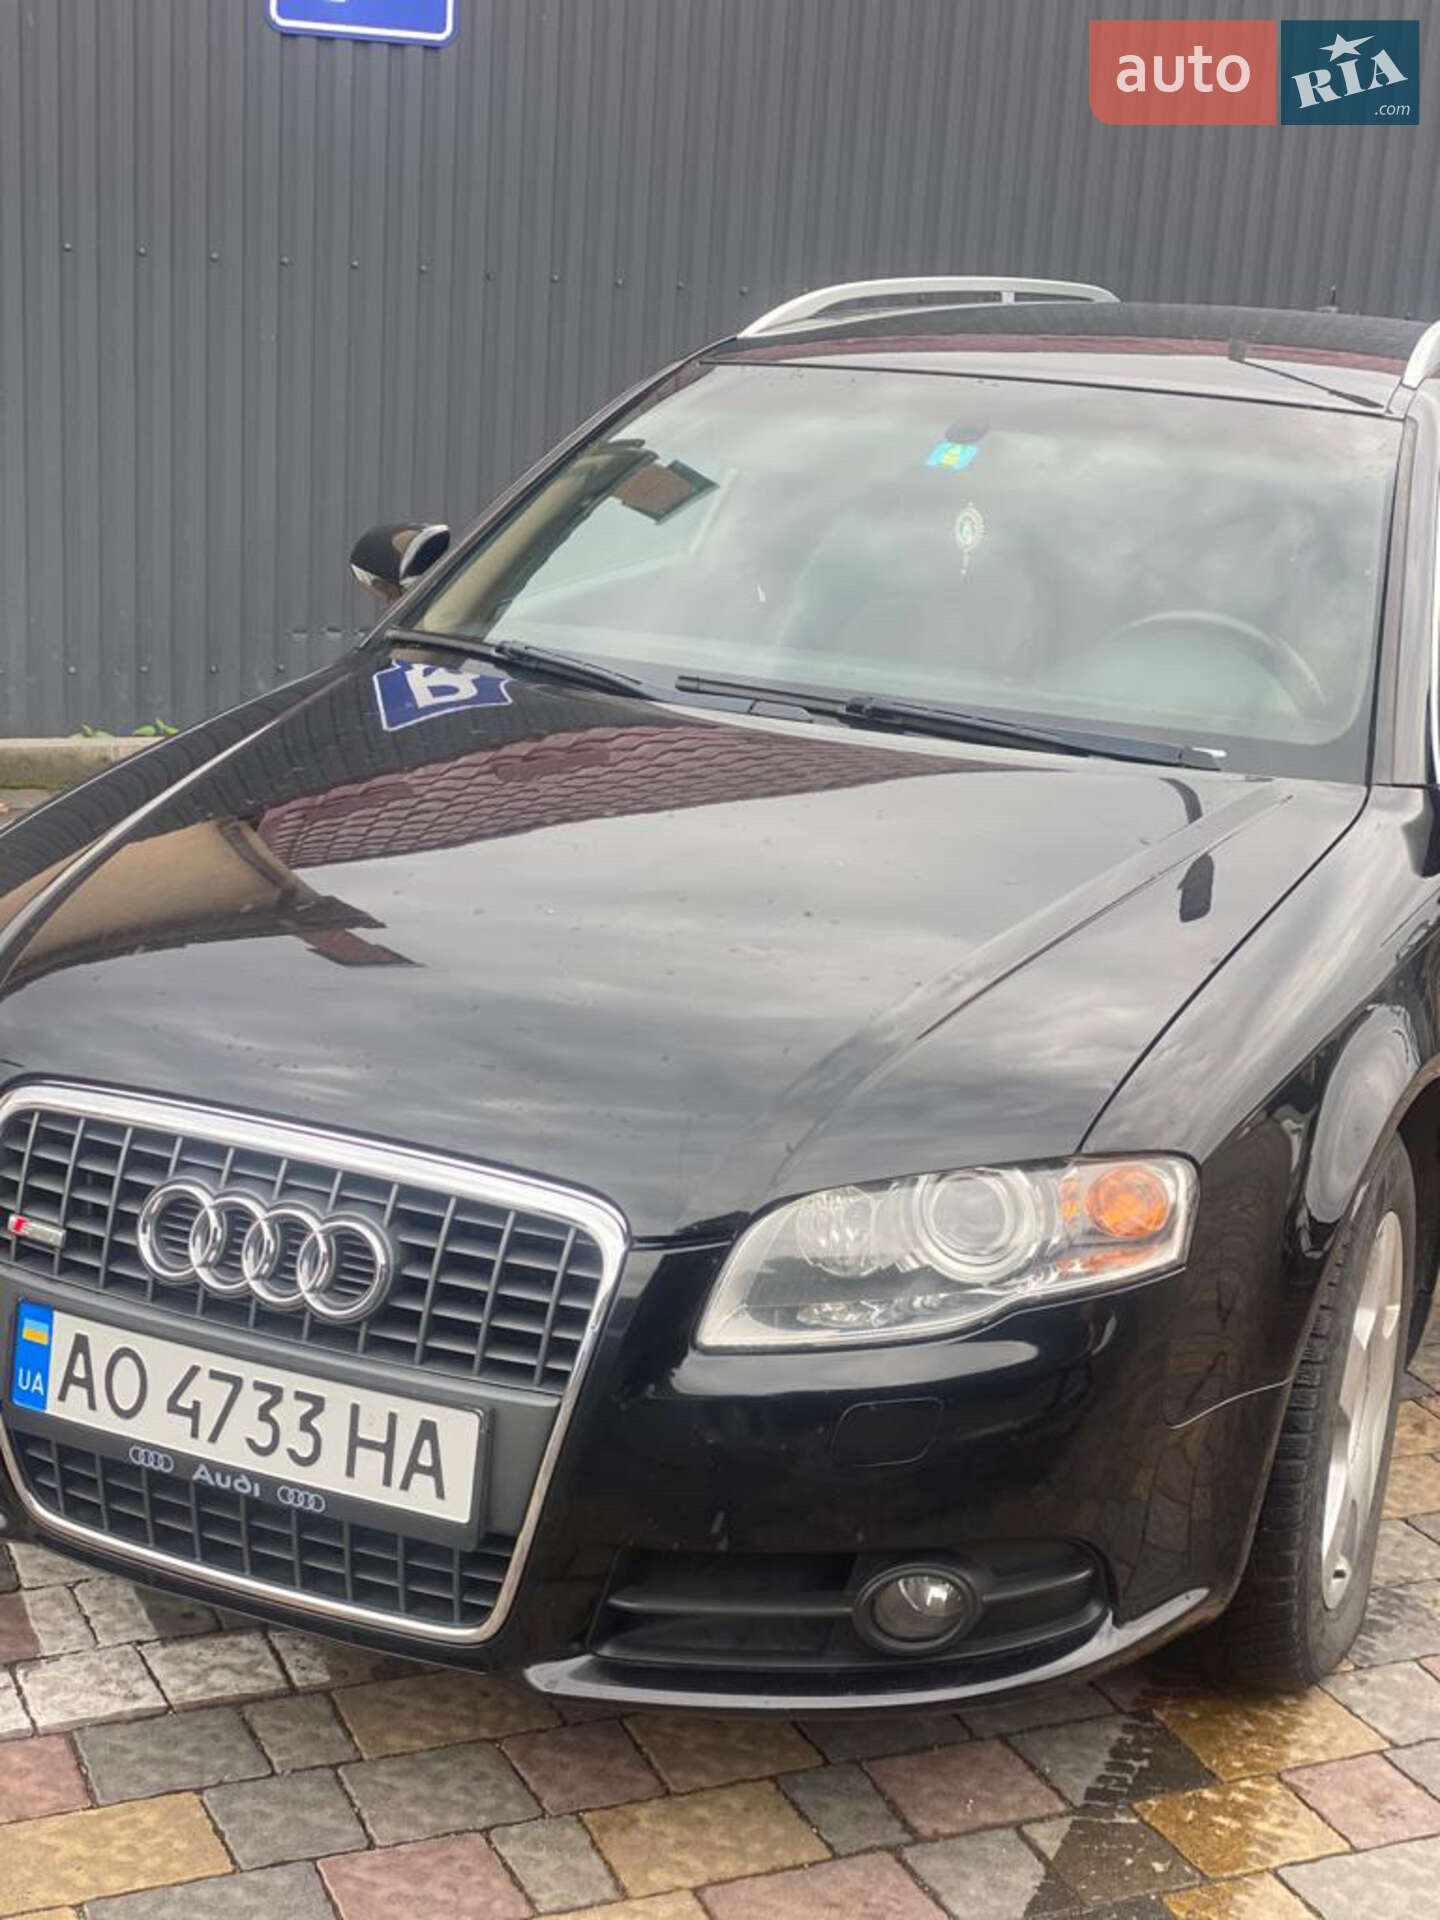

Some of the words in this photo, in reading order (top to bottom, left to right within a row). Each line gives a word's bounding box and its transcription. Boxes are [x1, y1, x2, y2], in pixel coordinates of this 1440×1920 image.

[17, 1366, 45, 1396] UA
[57, 1332, 148, 1420] AO
[166, 1363, 327, 1468] 4733
[345, 1402, 446, 1500] HA
[192, 1463, 261, 1497] Audi
